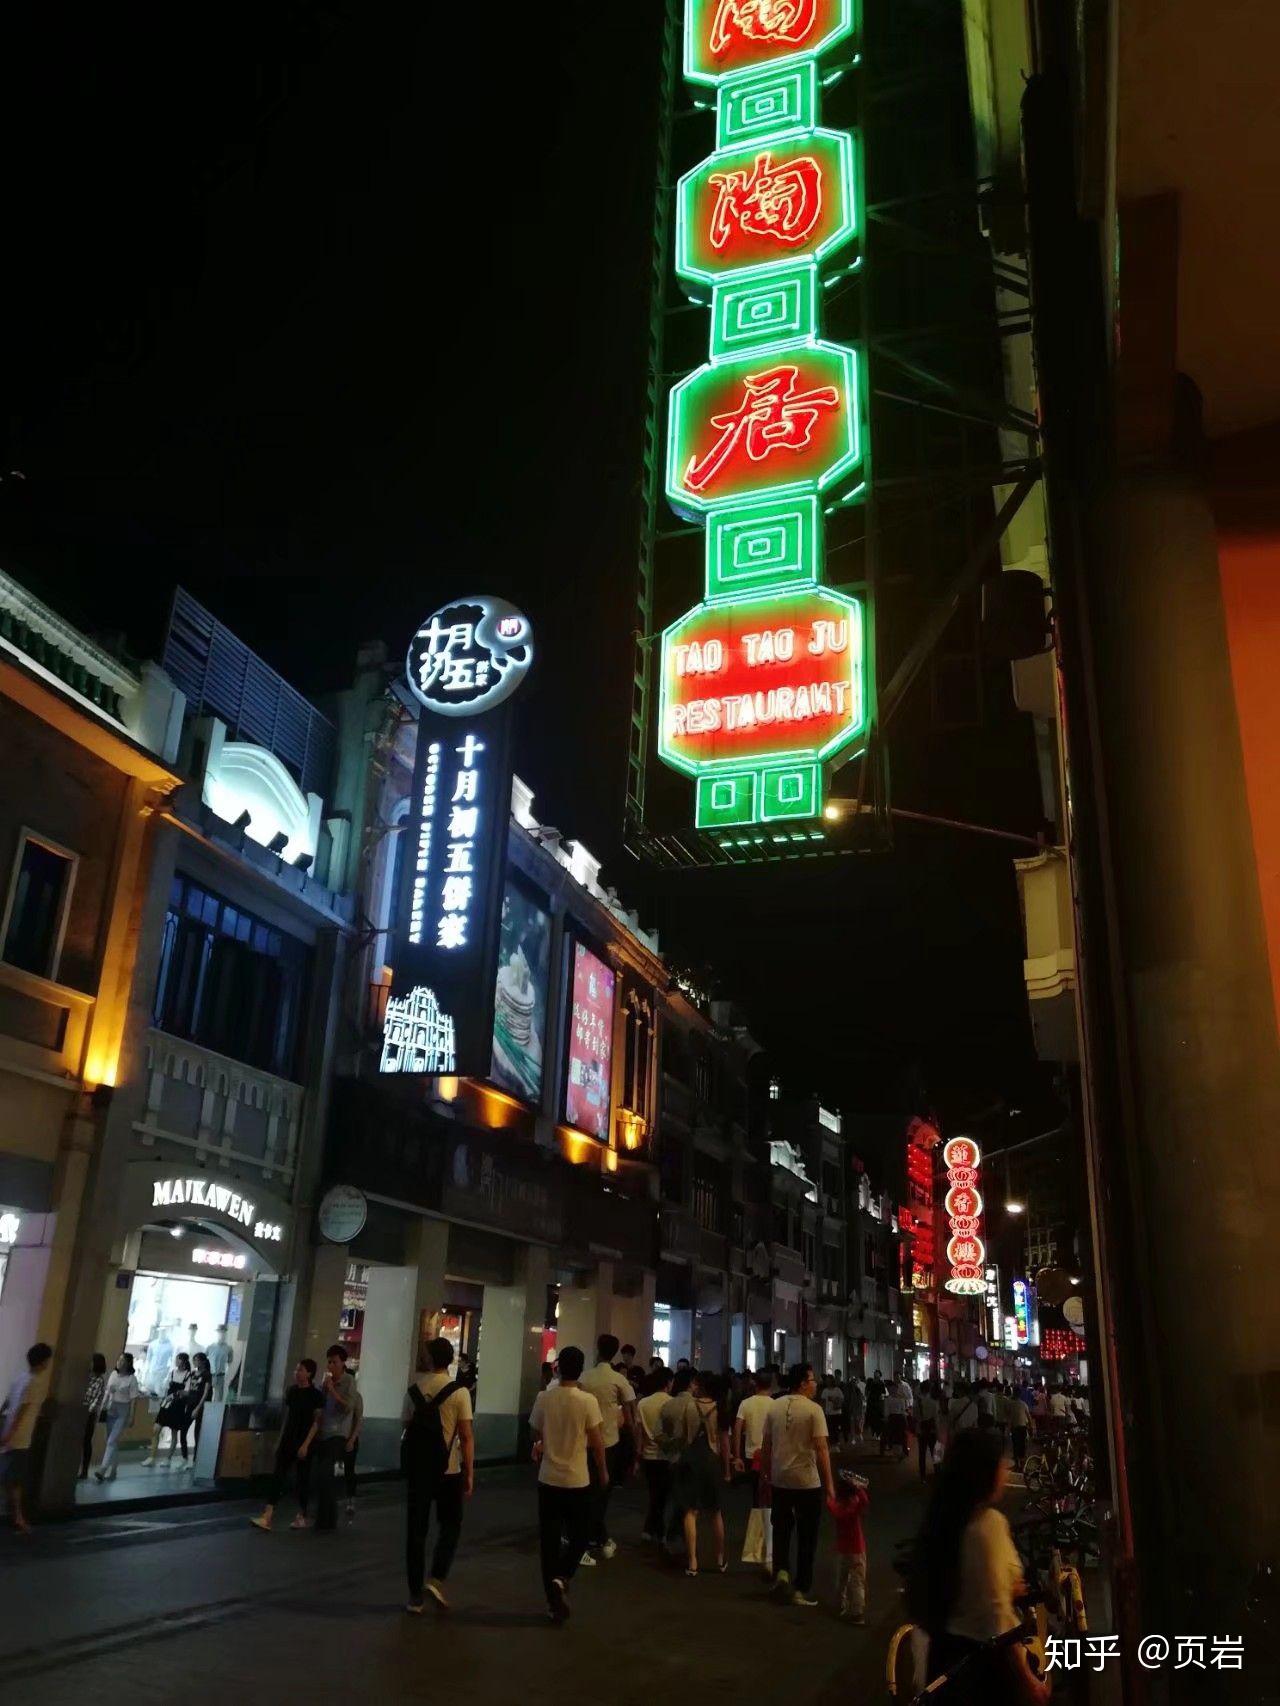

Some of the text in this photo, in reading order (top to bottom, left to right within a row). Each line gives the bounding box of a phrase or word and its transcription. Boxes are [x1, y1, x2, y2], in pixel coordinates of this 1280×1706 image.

[672, 619, 848, 676] TAO TAO JU
[671, 681, 850, 736] RESTAURANT
[152, 1179, 255, 1227] MAIKAWEN
